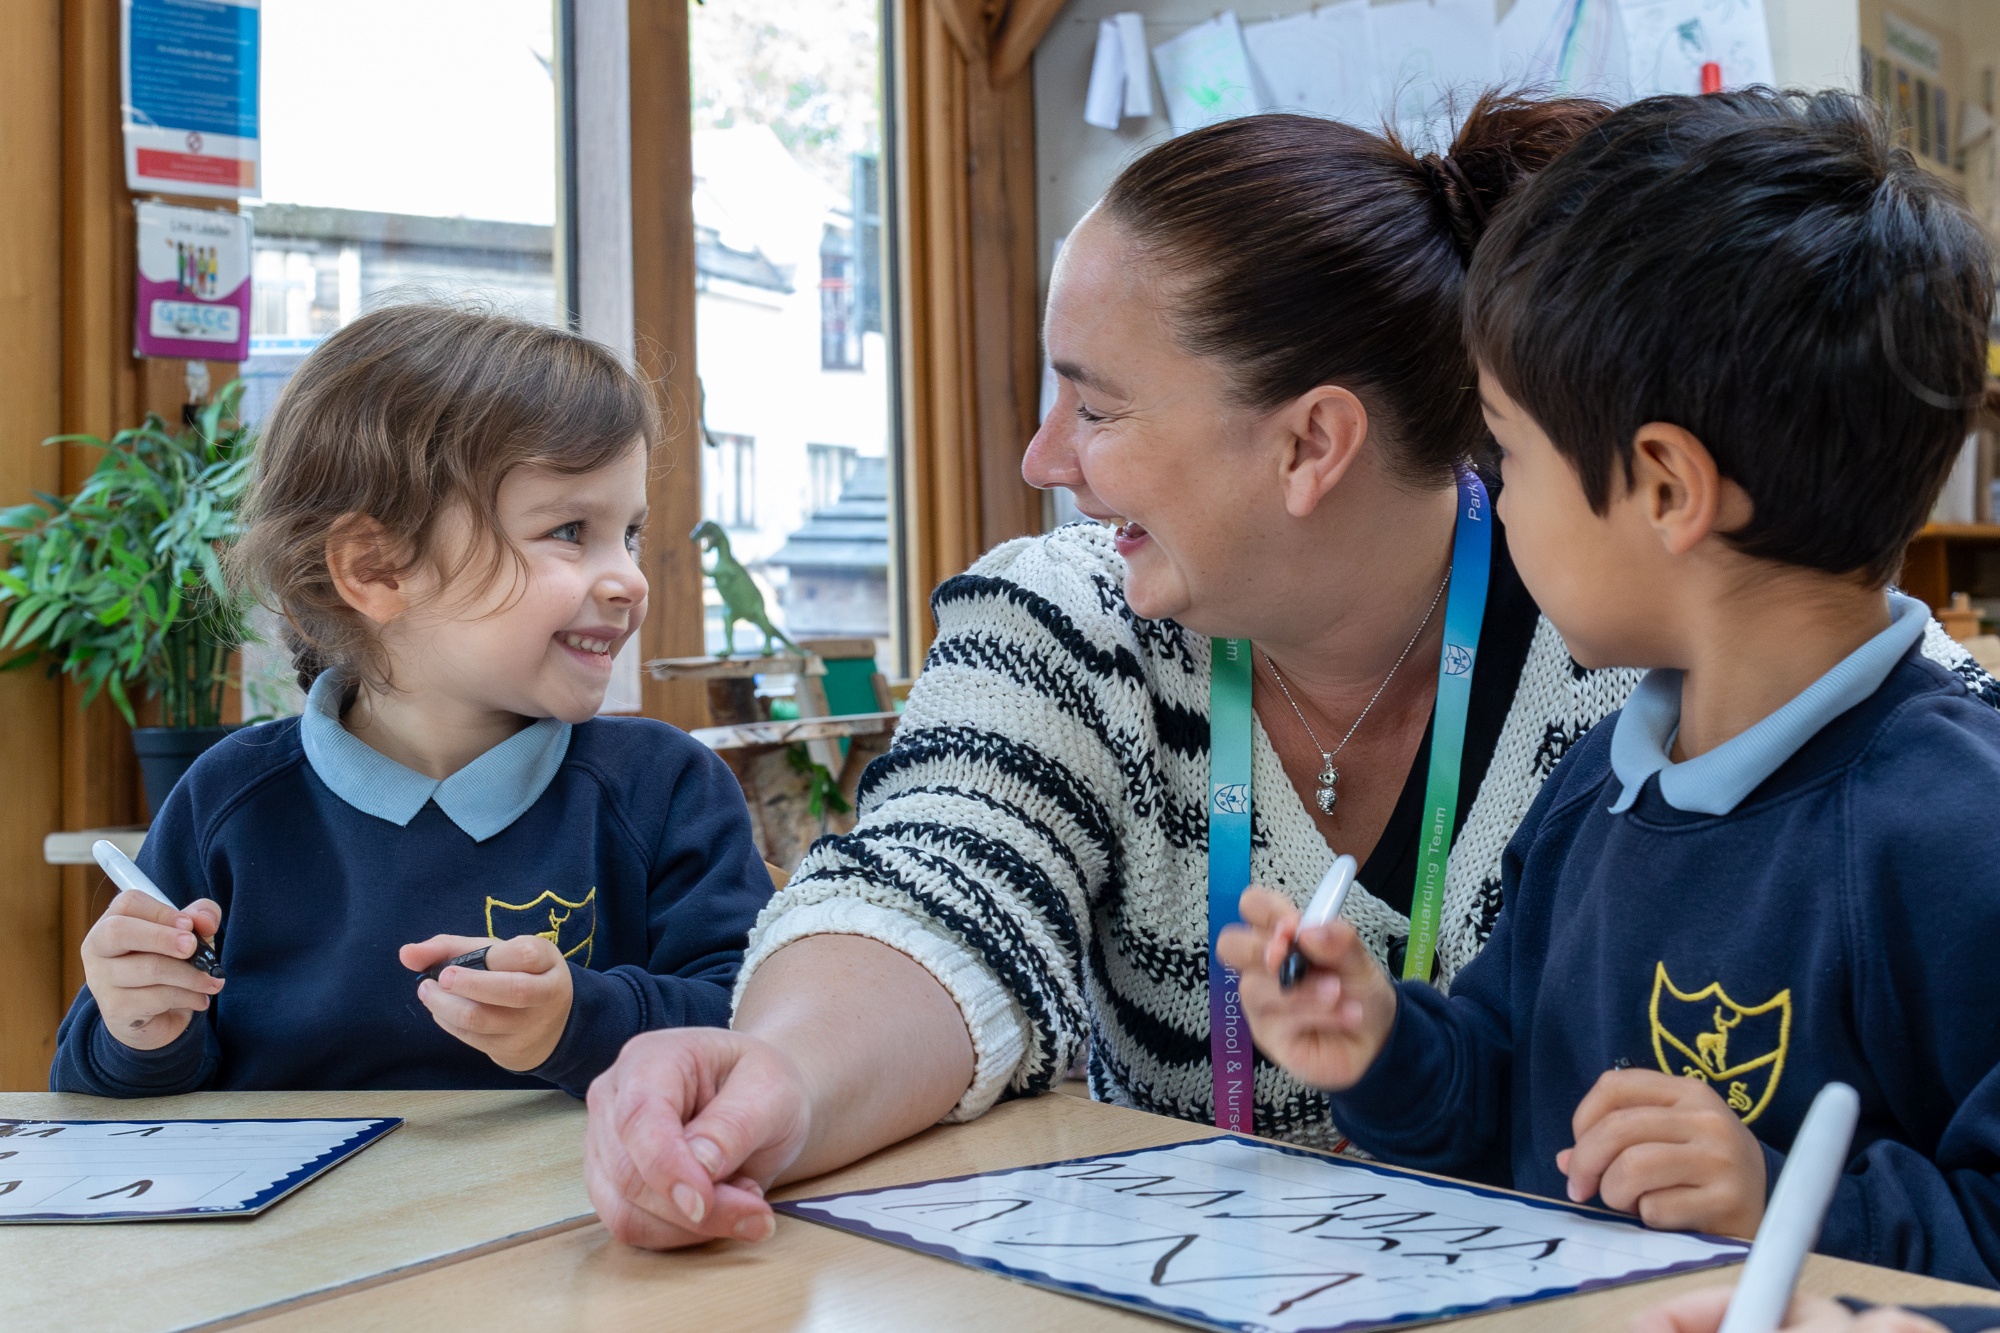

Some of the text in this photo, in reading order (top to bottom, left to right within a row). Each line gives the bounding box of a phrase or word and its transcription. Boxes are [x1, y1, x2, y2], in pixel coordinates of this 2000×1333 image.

[1467, 483, 1481, 521] Park
[1427, 807, 1446, 856] Team
[1225, 991, 1241, 1053] School
[1226, 1060, 1242, 1073] &
